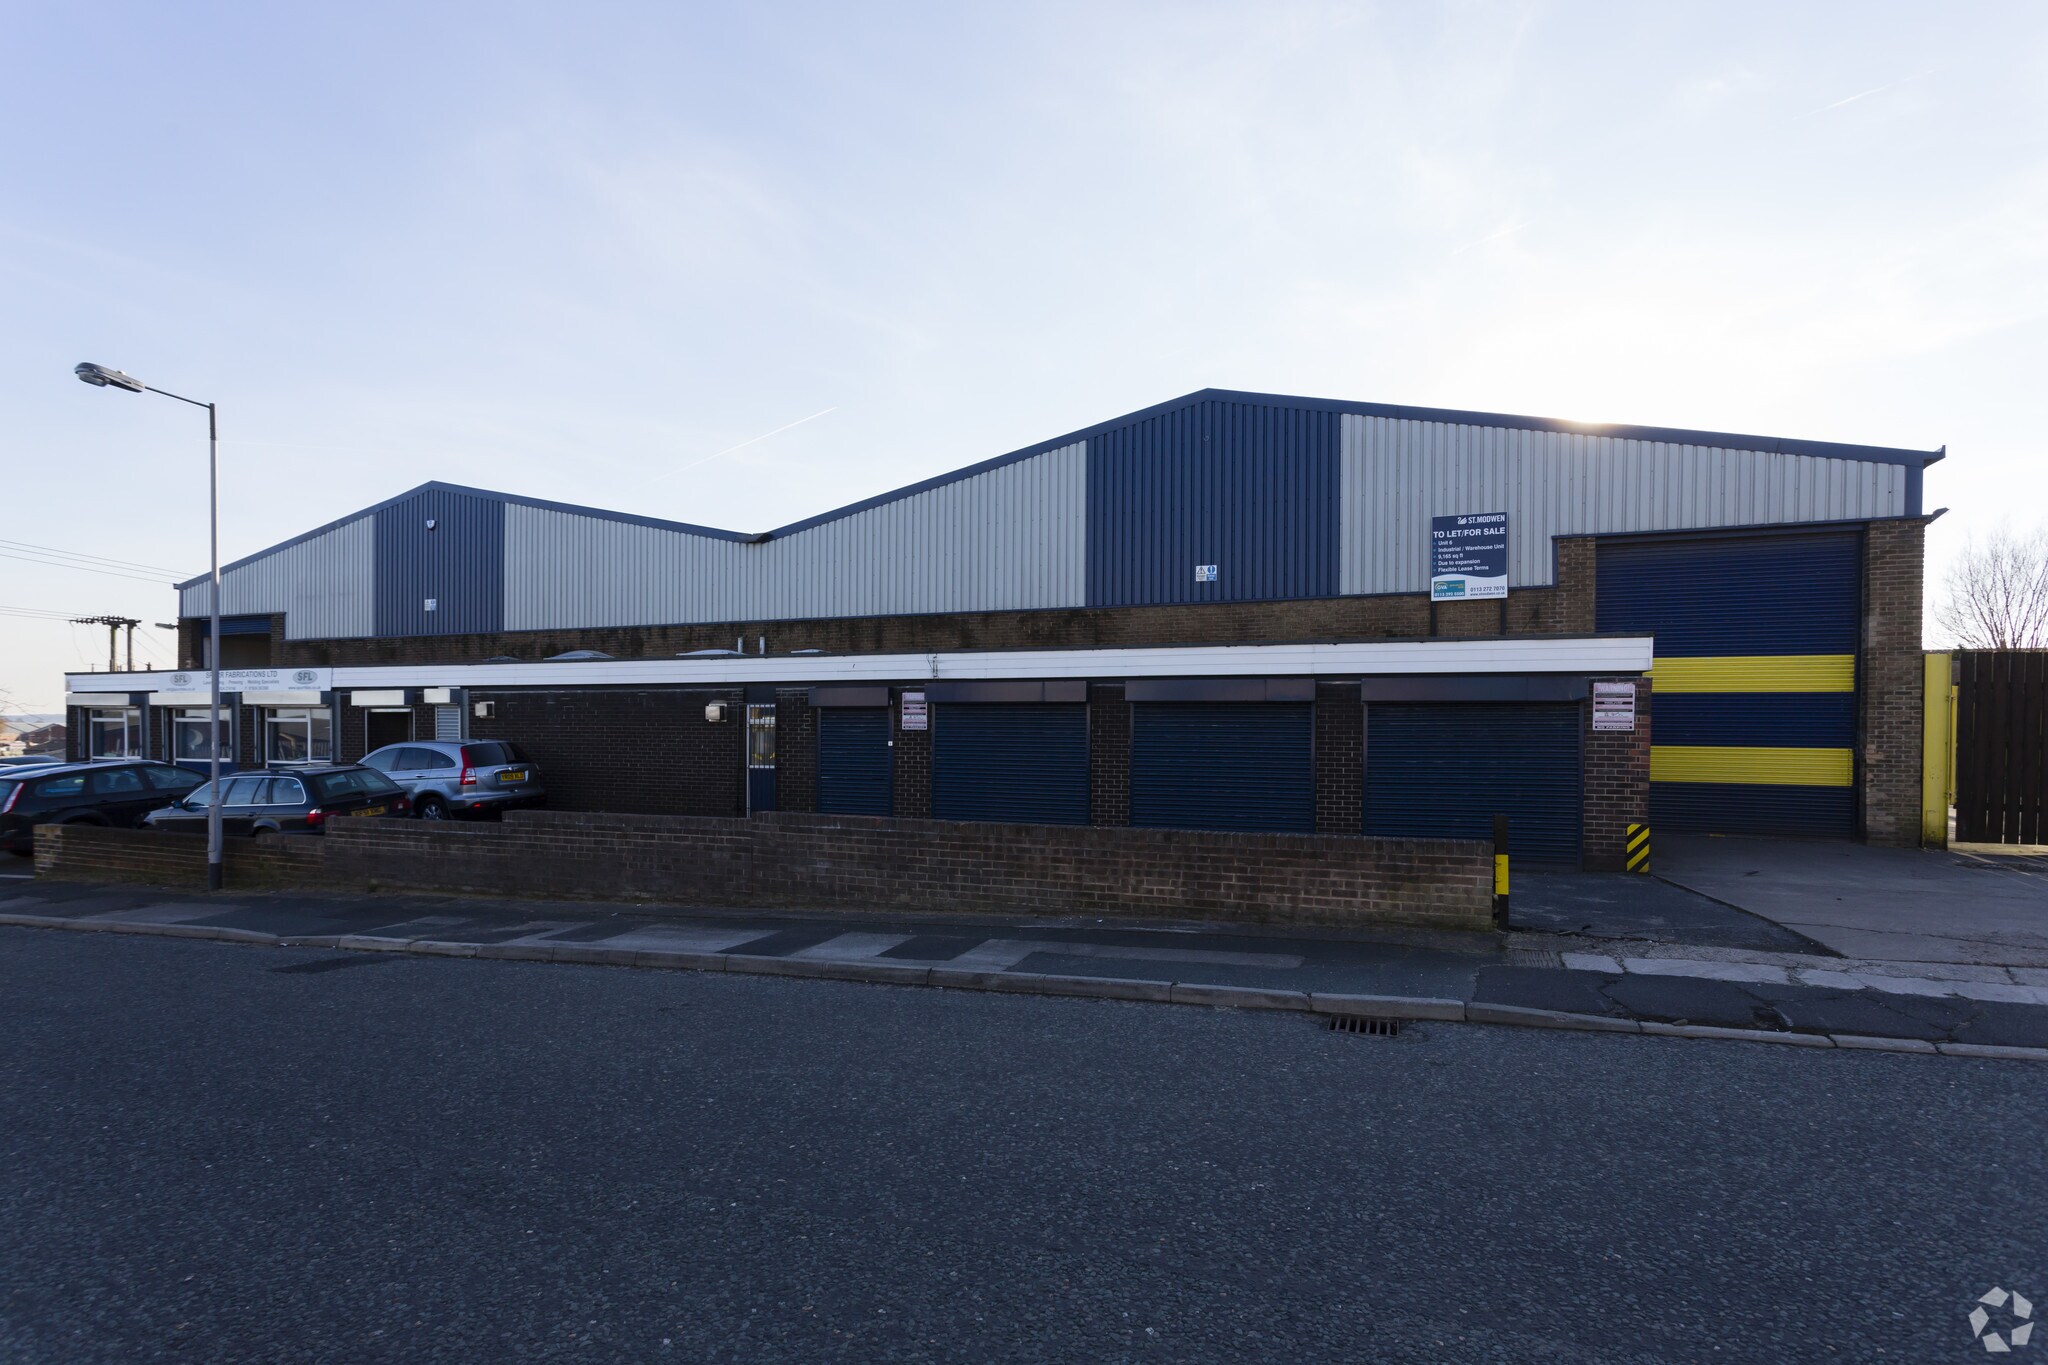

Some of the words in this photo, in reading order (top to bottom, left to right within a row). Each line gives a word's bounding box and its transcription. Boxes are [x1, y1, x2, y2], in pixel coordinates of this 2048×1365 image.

[1446, 529, 1481, 538] LET/FOR
[1483, 527, 1506, 535] SALE
[174, 674, 188, 683] SFL
[267, 670, 278, 678] LTD
[297, 672, 312, 681] SFL
